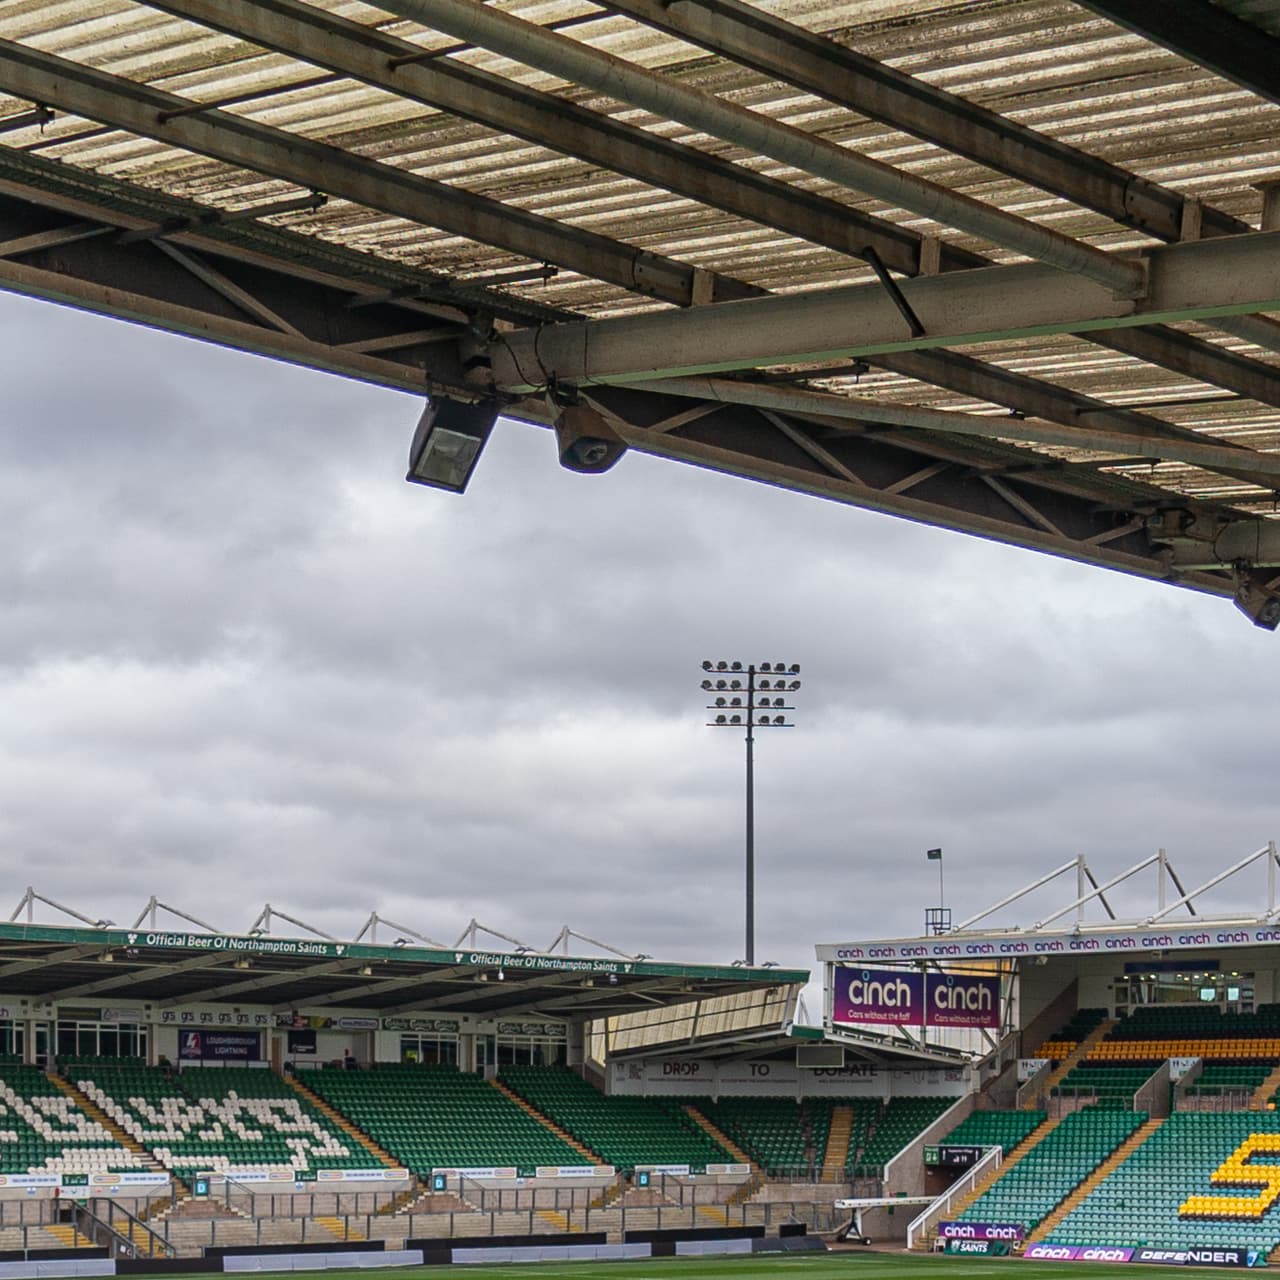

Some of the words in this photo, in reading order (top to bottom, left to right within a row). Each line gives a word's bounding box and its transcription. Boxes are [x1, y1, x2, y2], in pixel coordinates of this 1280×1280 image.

[146, 934, 185, 946] Official
[188, 936, 212, 947] Beer
[214, 937, 228, 948] Of
[229, 939, 296, 954] Northampton
[298, 943, 327, 954] Saints
[838, 948, 863, 959] cinch
[869, 947, 895, 958] cinch
[901, 946, 928, 957] cinch
[933, 944, 960, 956] cinch
[966, 942, 994, 954] cinch
[1000, 941, 1028, 953] cinch
[1034, 940, 1063, 952] cinch
[1070, 938, 1098, 950] cinch
[1106, 936, 1136, 949] cinch
[1142, 935, 1172, 947] cinch
[1179, 933, 1210, 945] cinch
[1217, 931, 1249, 943] cinch
[470, 953, 501, 965] Official
[503, 955, 523, 966] Beer
[524, 956, 536, 967] Of
[536, 957, 592, 972] Northampton
[593, 961, 618, 972] Saints
[848, 970, 911, 1008] cinch
[934, 976, 992, 1011] cinch
[848, 1009, 863, 1019] Cars
[864, 1010, 887, 1020] without
[888, 1012, 898, 1020] the
[934, 1013, 948, 1022] Cars
[949, 1014, 970, 1023] without
[971, 1015, 980, 1024] the
[206, 1036, 257, 1046] LOUGHBOROUGH
[215, 1047, 248, 1055] LIGHTNING
[663, 1063, 699, 1075] DROP
[751, 1064, 769, 1076] TO
[435, 1177, 443, 1188] D
[639, 1174, 647, 1184] D
[196, 1181, 206, 1194] D
[945, 1224, 975, 1238] cinch
[986, 1224, 1017, 1239] cinch
[960, 1243, 988, 1253] SAINTS
[1031, 1245, 1070, 1259] cinch
[1083, 1248, 1125, 1261] cinch
[1140, 1251, 1239, 1264] DEFENDER
